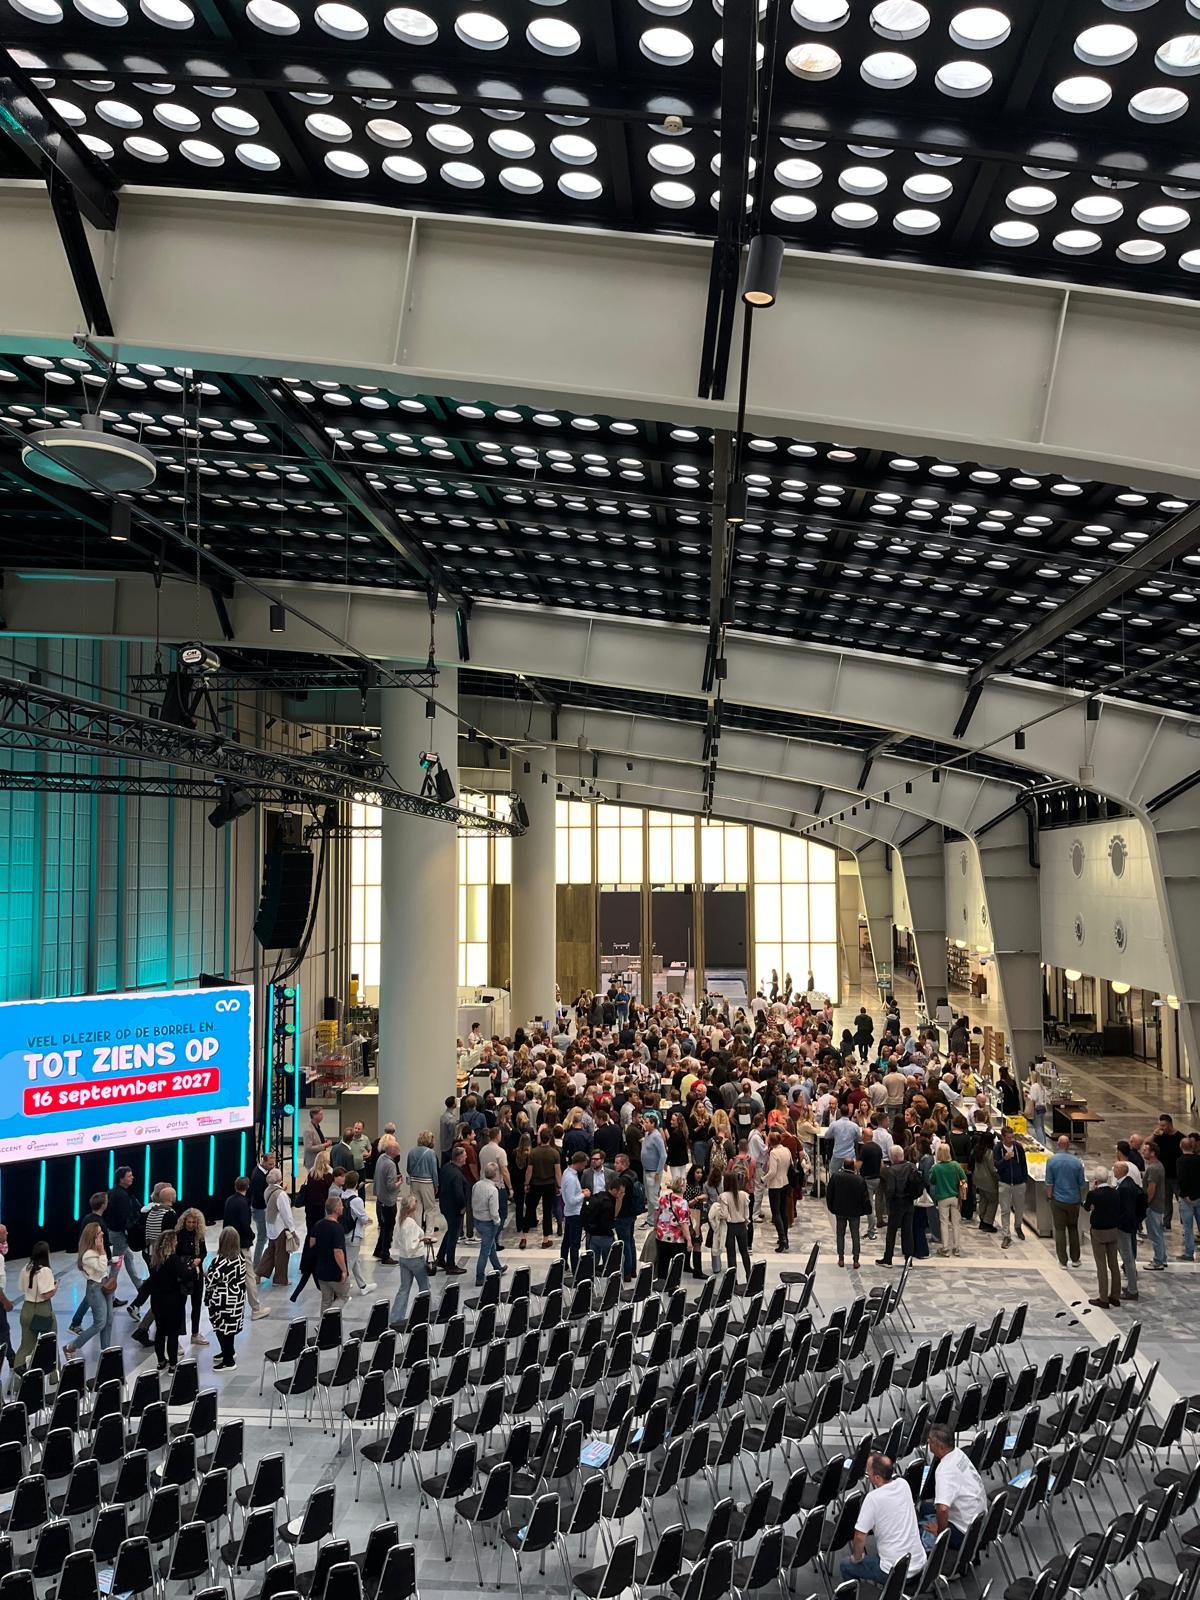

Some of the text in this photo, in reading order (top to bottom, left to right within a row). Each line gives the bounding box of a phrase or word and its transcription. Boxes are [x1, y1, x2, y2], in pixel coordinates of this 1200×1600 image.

[27, 1036, 57, 1048] VEEL
[62, 1031, 111, 1045] PLEZIER
[116, 1029, 131, 1040] OP
[135, 1027, 149, 1038] DE
[153, 1023, 195, 1037] BORREL
[23, 1036, 219, 1080] TOT ZIENS OP
[32, 1072, 212, 1108] 16 september 2027
